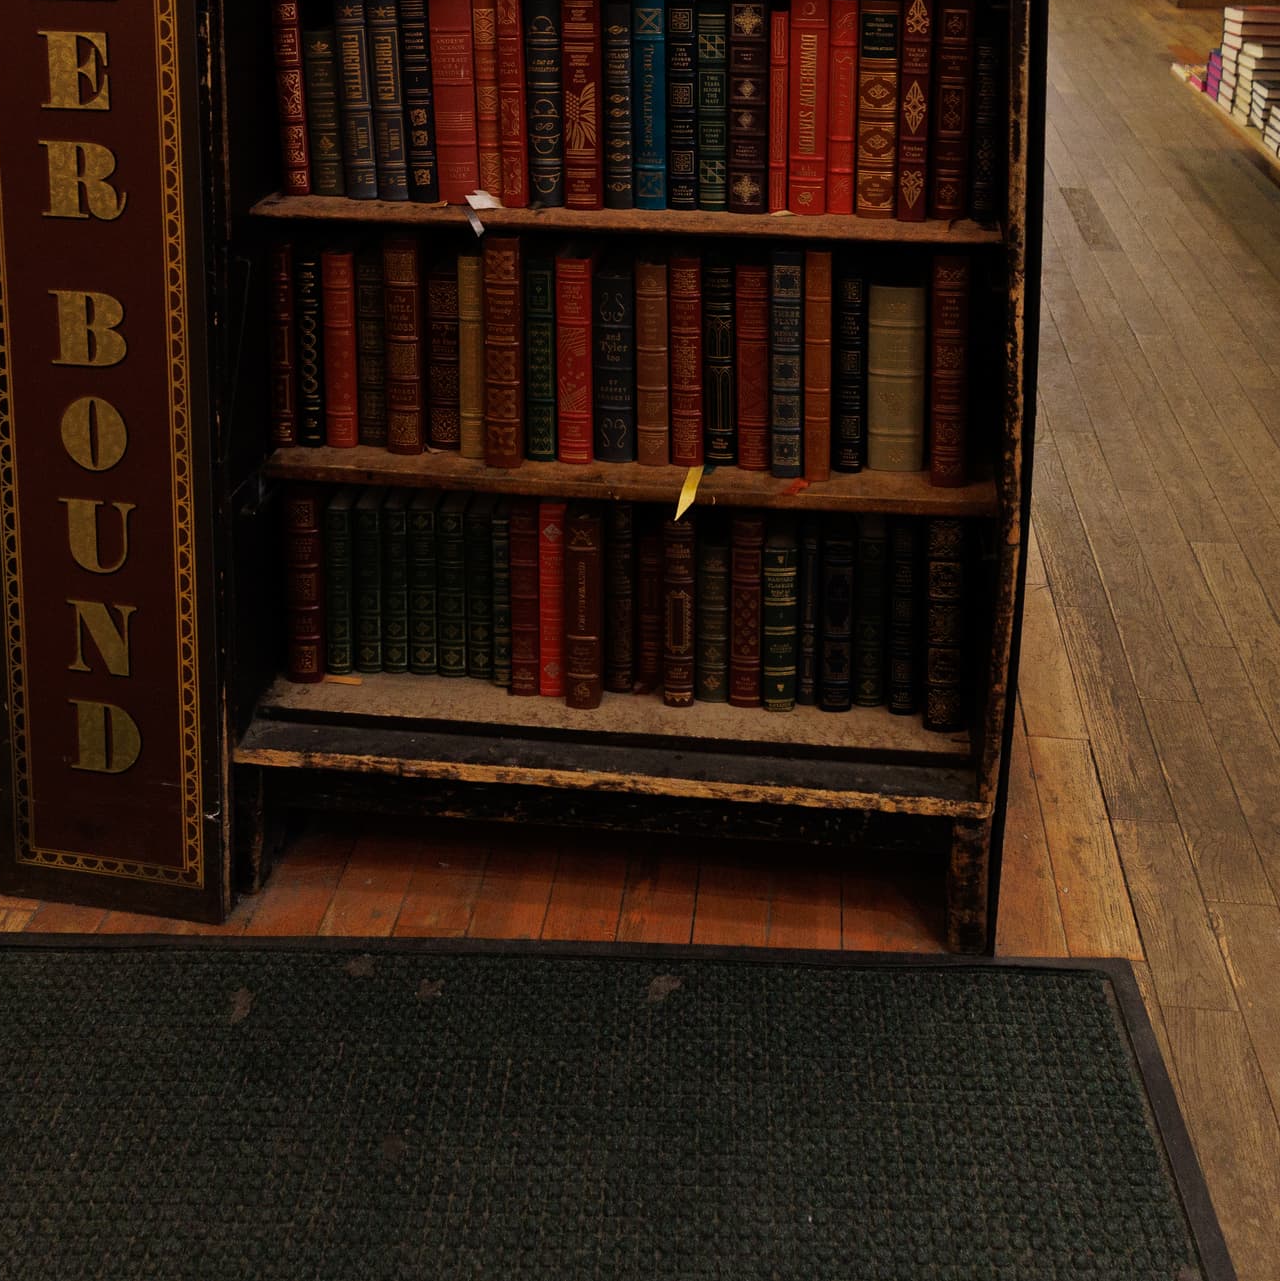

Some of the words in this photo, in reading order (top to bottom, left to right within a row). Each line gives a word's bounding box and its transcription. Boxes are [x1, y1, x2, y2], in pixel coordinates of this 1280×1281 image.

[800, 33, 817, 108] DOWNBELOW
[799, 111, 816, 154] STATION
[47, 288, 141, 774] BOUND
